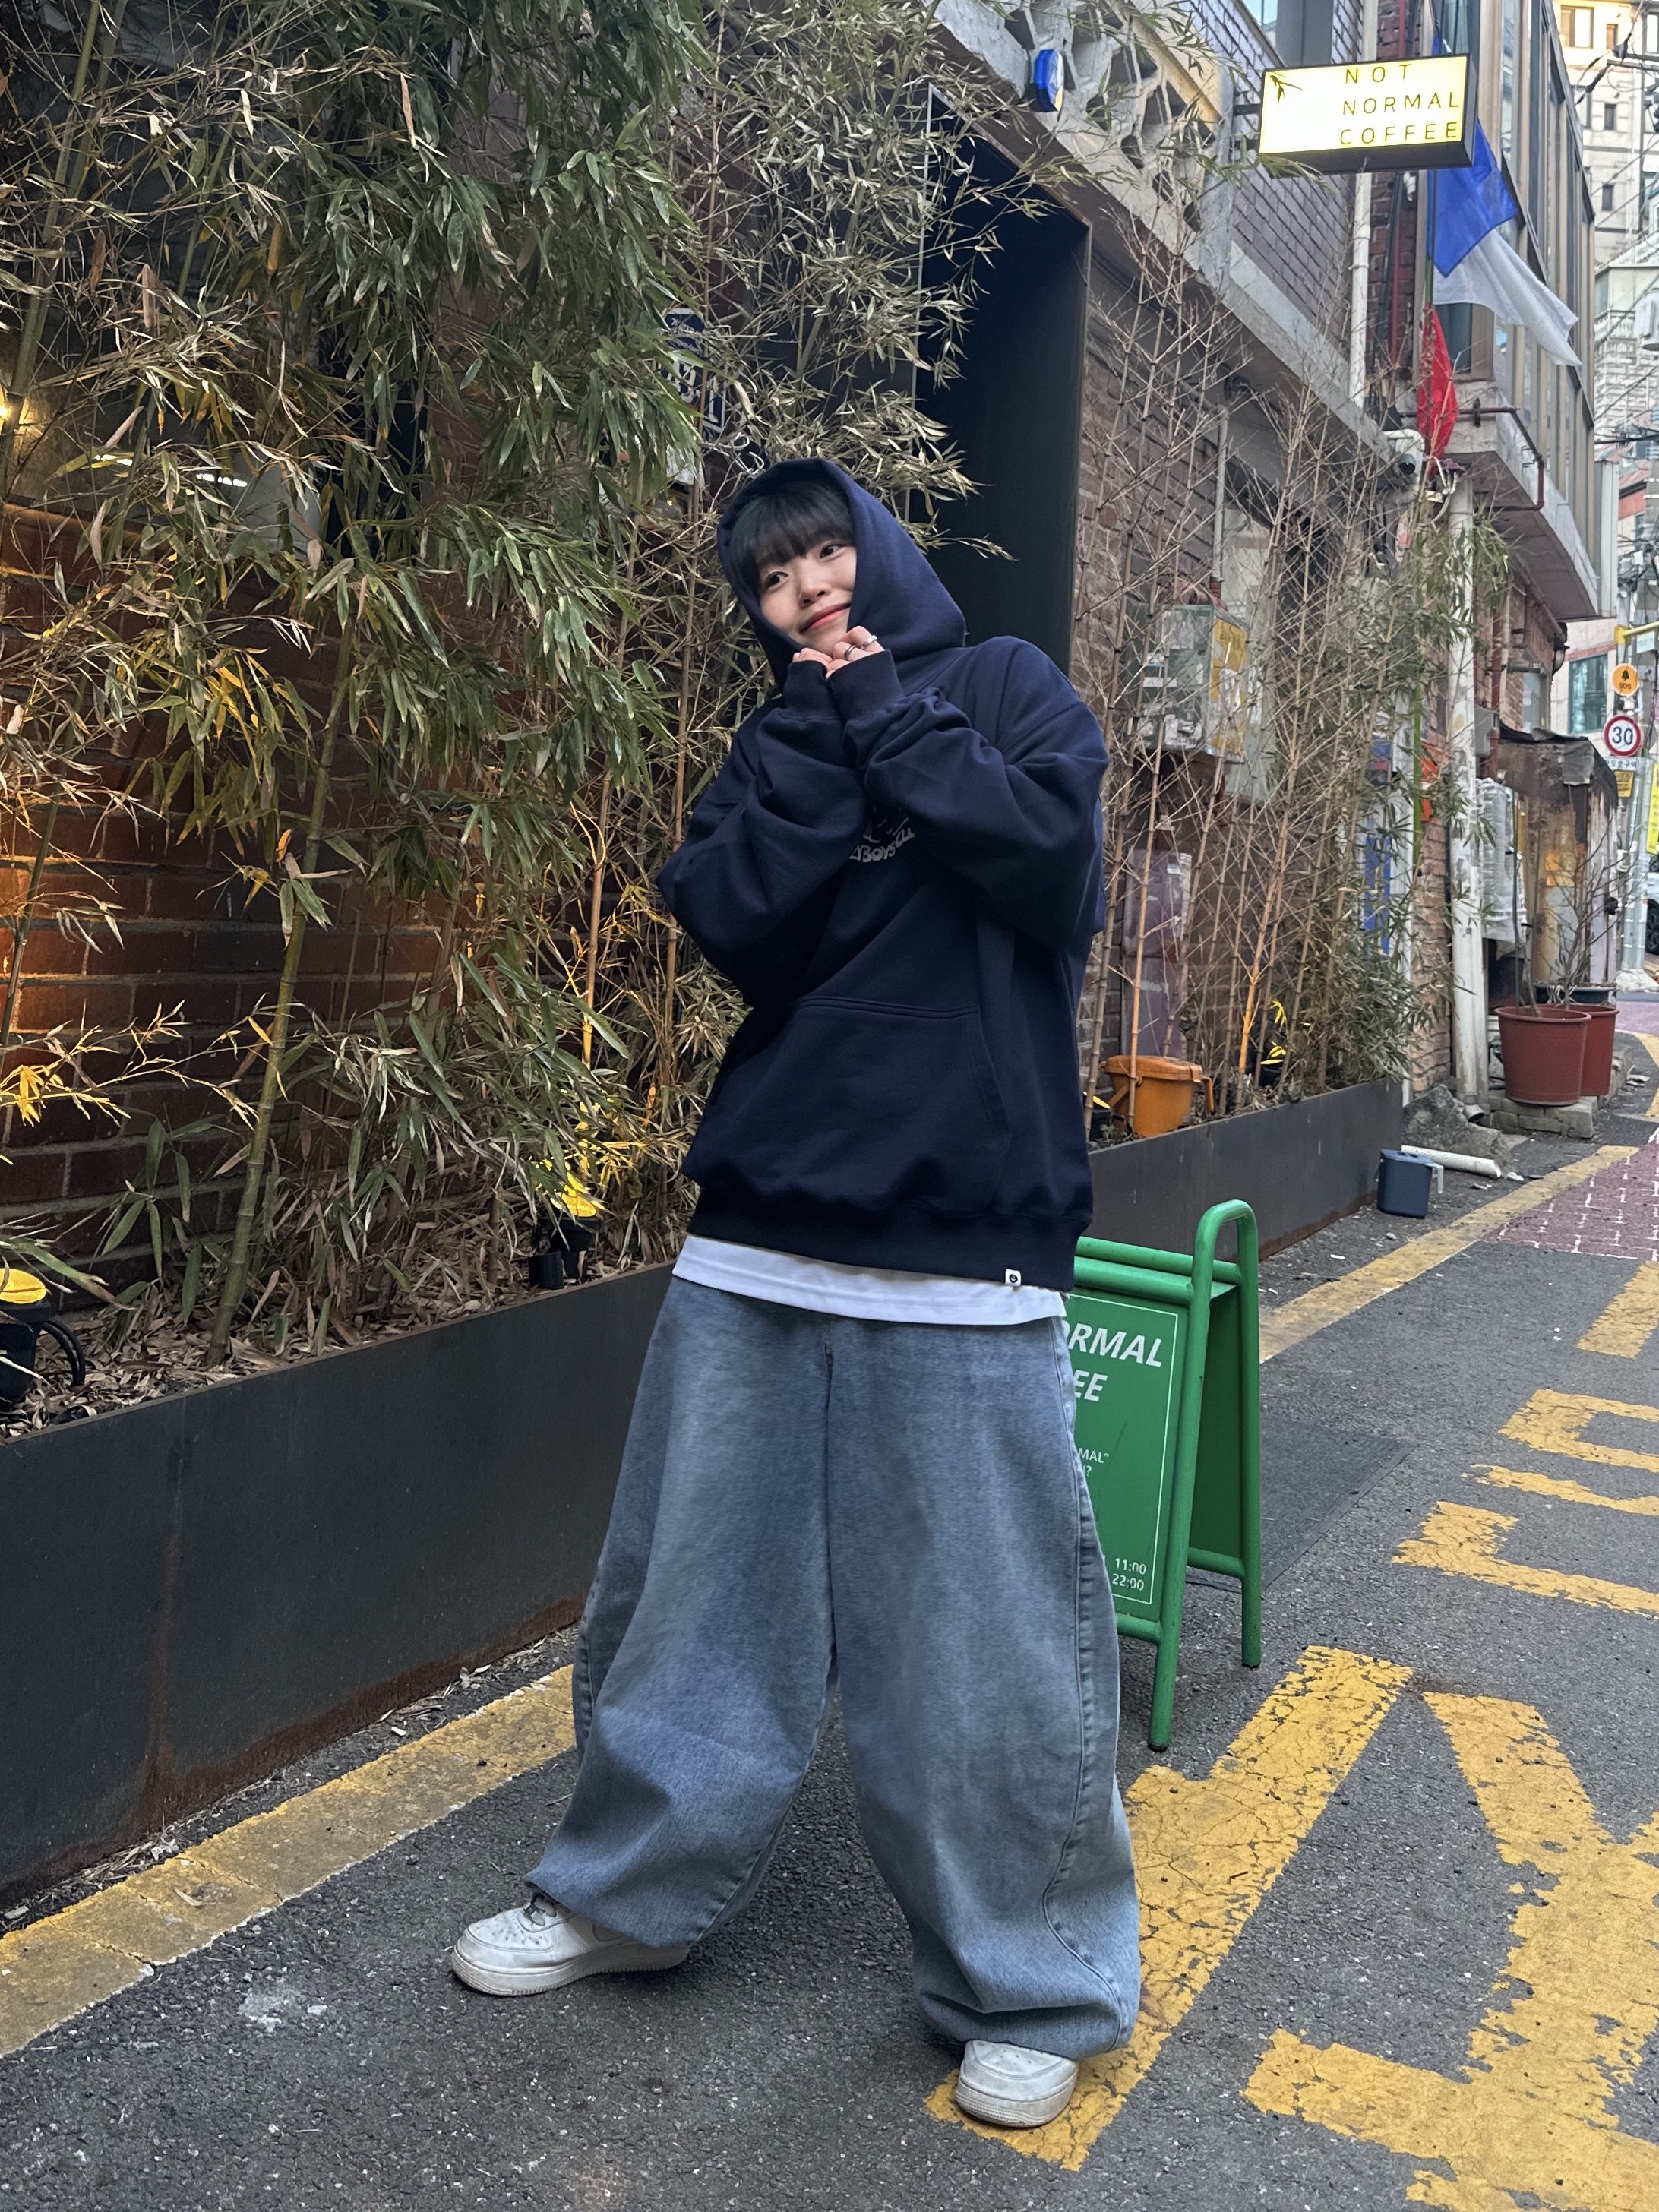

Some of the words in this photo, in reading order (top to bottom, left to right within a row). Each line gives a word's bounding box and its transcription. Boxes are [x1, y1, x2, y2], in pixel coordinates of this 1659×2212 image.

[1345, 64, 1411, 84] NOT
[1343, 92, 1459, 115] NORMAL
[1340, 122, 1457, 145] COFFEE
[1618, 682, 1632, 690] SOS
[1612, 726, 1633, 745] 30
[1115, 1558, 1147, 1575] 11:00
[1111, 1573, 1145, 1591] 22:00
